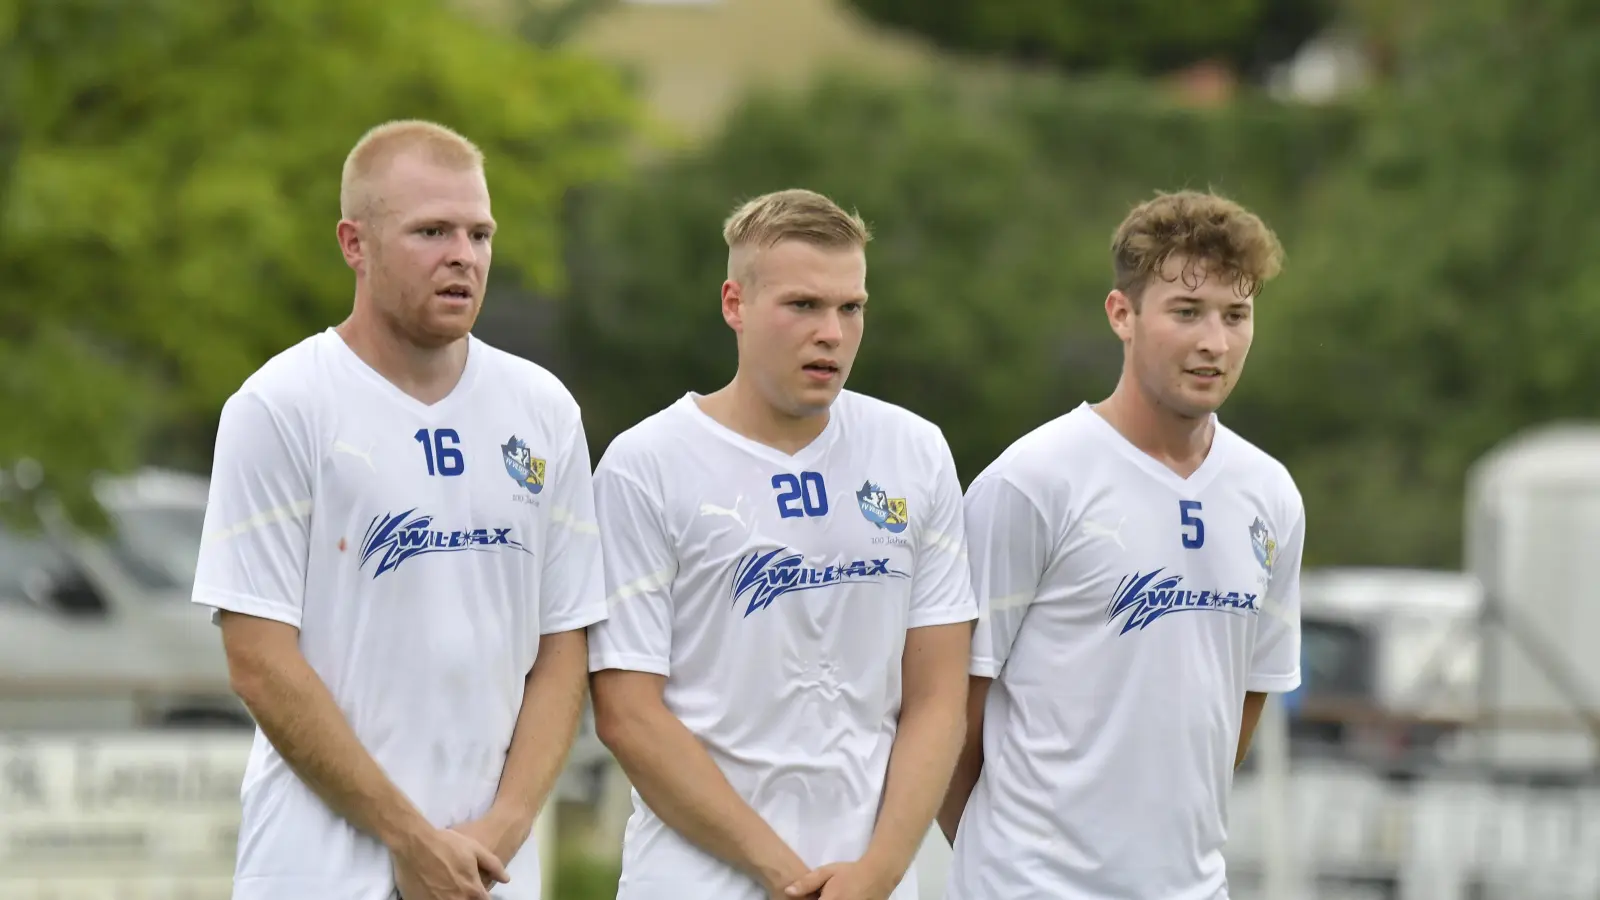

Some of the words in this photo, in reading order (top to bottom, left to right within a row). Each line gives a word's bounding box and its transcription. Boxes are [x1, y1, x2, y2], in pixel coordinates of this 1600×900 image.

[414, 428, 465, 476] 16
[771, 471, 829, 518] 20
[1179, 500, 1205, 549] 5
